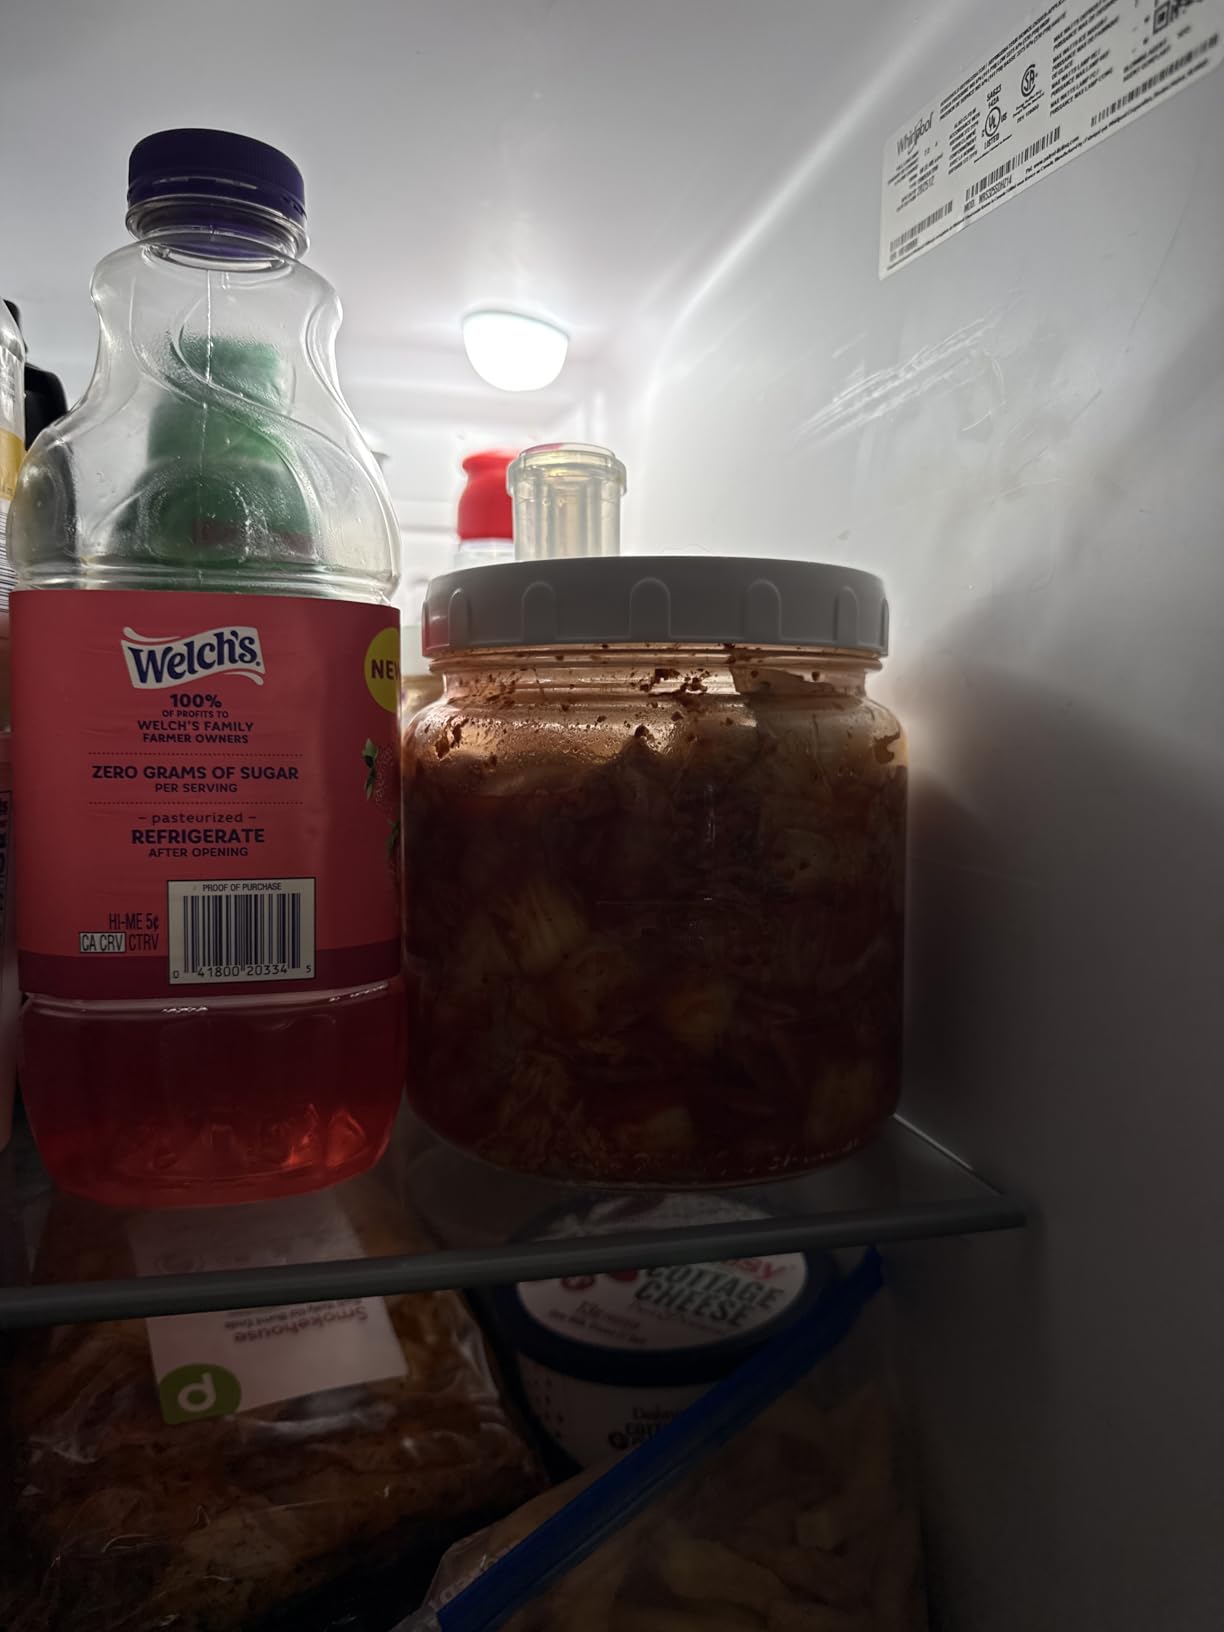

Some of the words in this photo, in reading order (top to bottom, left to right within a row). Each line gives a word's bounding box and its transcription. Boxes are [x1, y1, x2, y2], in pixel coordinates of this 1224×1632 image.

[128, 631, 258, 683] Welch's
[170, 693, 222, 708] 100%
[162, 710, 173, 718] OF
[177, 710, 214, 718] PROFITS
[217, 710, 229, 718] TO
[137, 720, 200, 731] WELCH'S
[204, 721, 254, 732] FAMILY
[143, 733, 192, 743] FARMER
[195, 734, 249, 744] OWNERS
[92, 766, 138, 779] ZERO
[143, 766, 207, 779] GRAMS
[212, 766, 236, 780] OF
[240, 767, 299, 780] SUGAR
[155, 783, 178, 793] PER
[183, 783, 238, 793] SERVING
[151, 812, 244, 825] pasteurized
[131, 828, 265, 844] REFRIGERATE
[148, 848, 188, 857] AFTER
[192, 847, 249, 857] OPENING
[202, 884, 228, 892] PROOF
[230, 883, 241, 891] OF
[242, 882, 282, 891] PURCHASE
[108, 912, 143, 930] HI-ME
[82, 934, 97, 951] CA
[99, 934, 124, 951] CRV
[128, 934, 159, 951] CTRV
[197, 965, 240, 978] 41800
[246, 964, 288, 977] 20334
[305, 964, 312, 974] 5
[635, 1280, 746, 1327] CHEESE
[233, 1305, 368, 1343] Smokehouse
